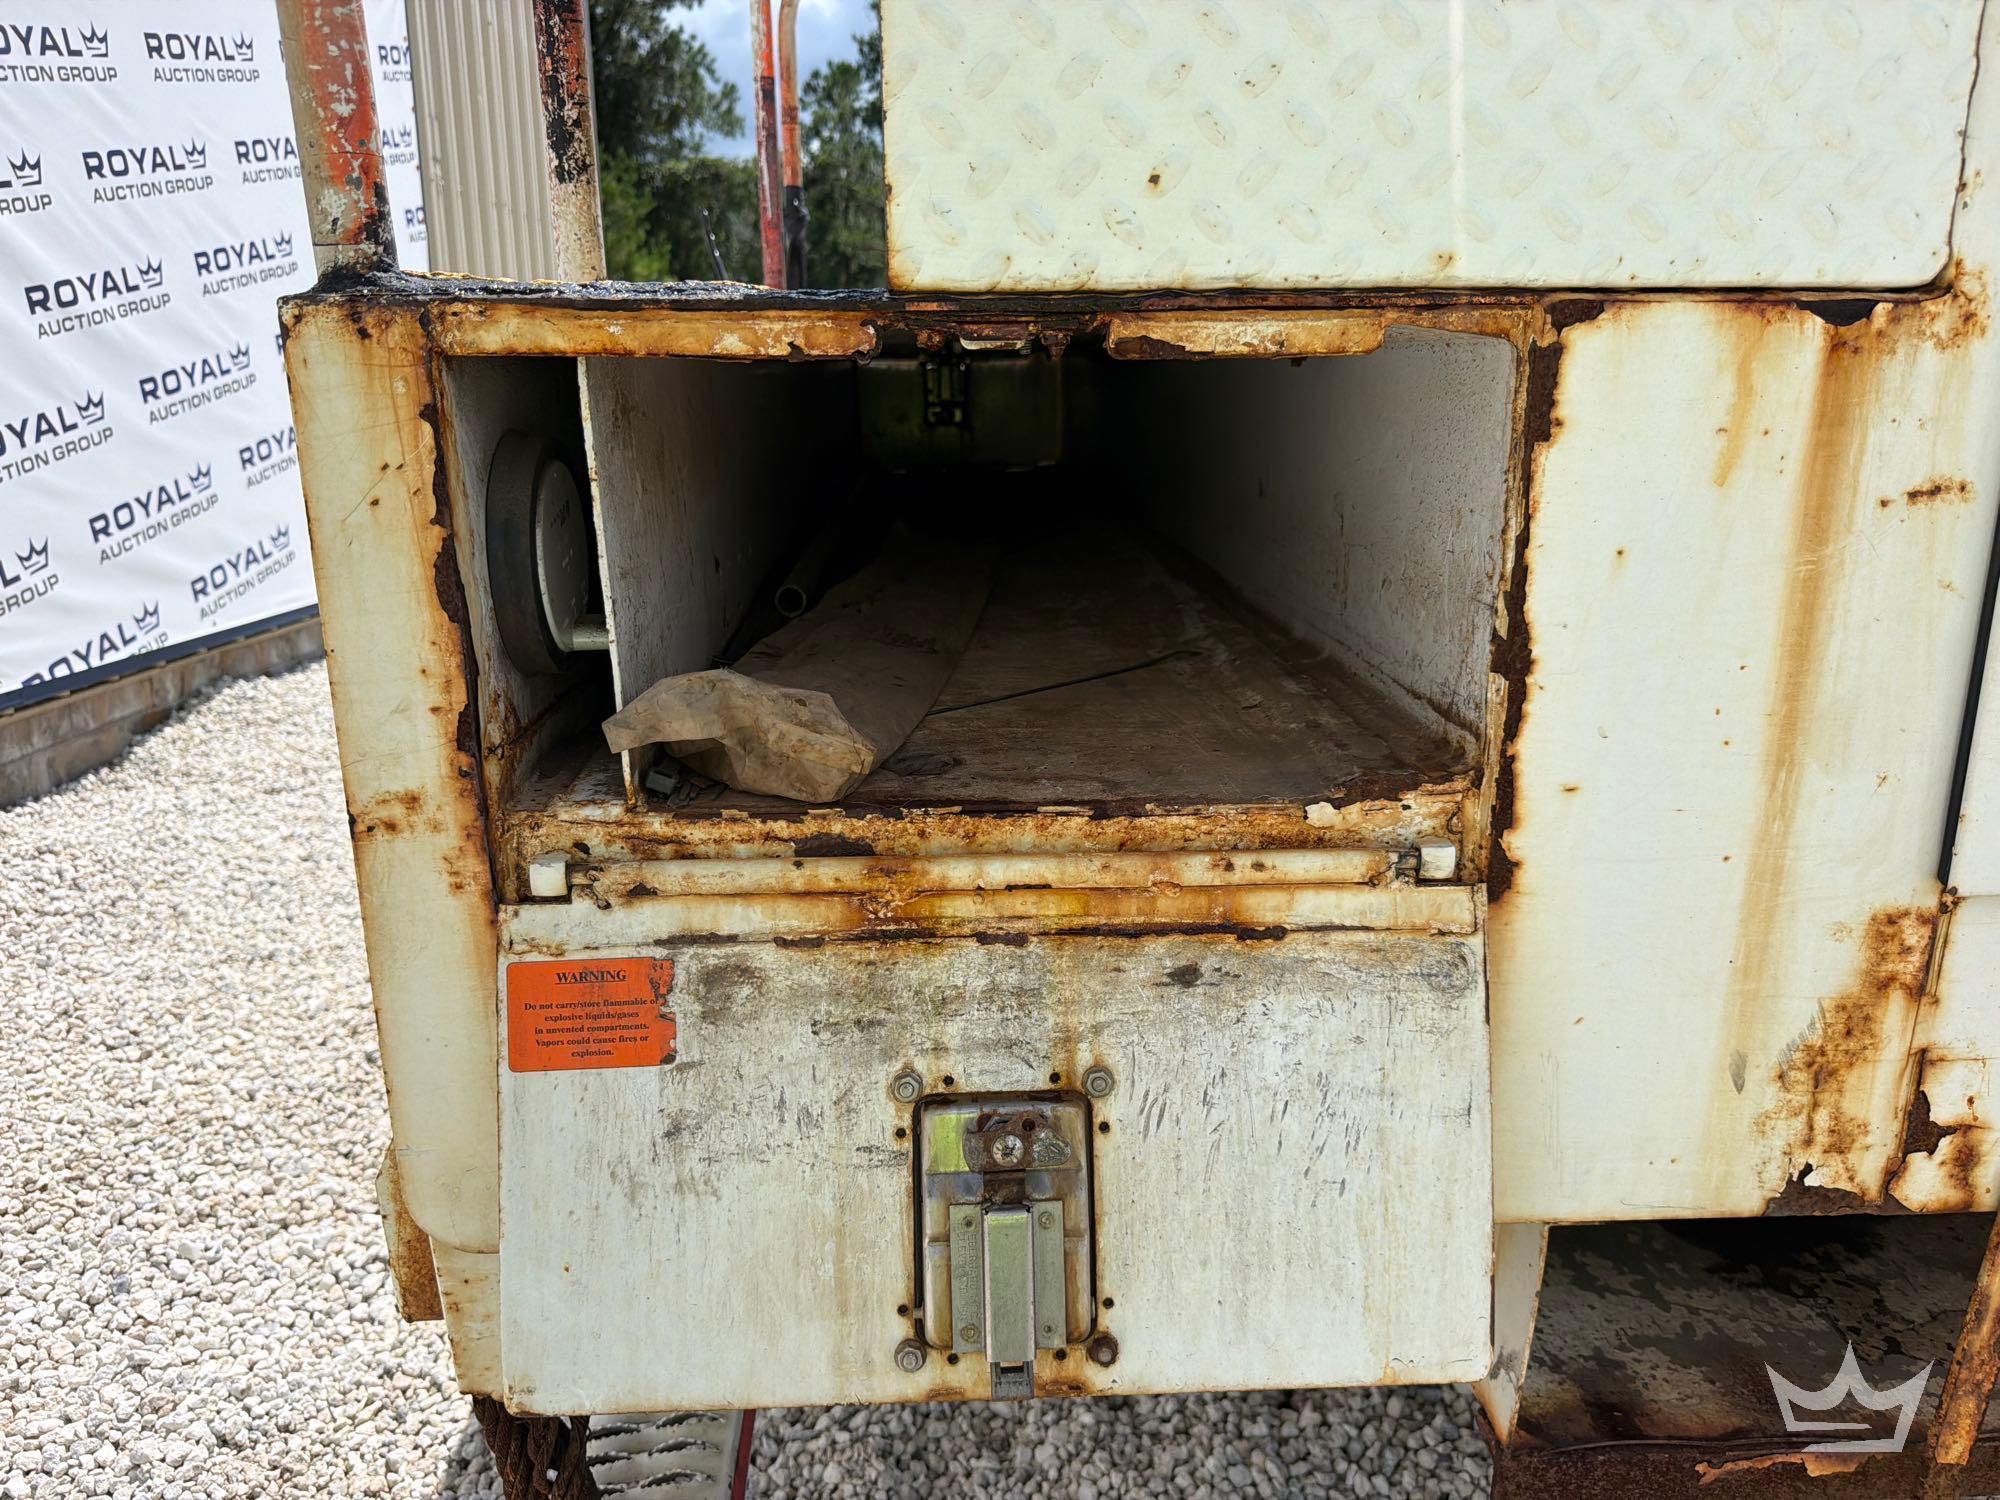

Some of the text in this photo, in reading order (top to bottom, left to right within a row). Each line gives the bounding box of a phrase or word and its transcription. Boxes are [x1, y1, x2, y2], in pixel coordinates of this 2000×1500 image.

[143, 32, 235, 61] ROYAL
[378, 45, 410, 65] ROY
[0, 65, 118, 82] CTION GROUP
[153, 67, 260, 83] AUCTION GROUP
[81, 146, 186, 180] ROYAL
[234, 137, 297, 165] ROYA
[93, 176, 214, 204] AUCTION GROUP
[242, 166, 292, 184] AUCTION
[0, 194, 52, 215] ROUP
[194, 238, 276, 277] ROYAL
[24, 265, 140, 316] ROYAL
[202, 262, 299, 298] AUCTION GROUP
[37, 293, 171, 339] AUCTION GROUP
[139, 353, 231, 404] ROYAL
[149, 373, 257, 425] AUCTION GROUP
[0, 406, 78, 457] YAL
[239, 426, 296, 471] ROYA
[0, 427, 114, 484] TION GROUP
[89, 478, 191, 544] ROYAL
[100, 493, 219, 565] AUCTION GROUP
[190, 539, 273, 604] ROYAL
[200, 551, 296, 621] AUCTION GROUP
[0, 574, 59, 618] ROUP
[556, 969, 627, 983] WARNING
[524, 1002, 536, 1011] Do
[539, 1002, 553, 1010] not
[555, 1000, 600, 1010] carry/store
[603, 998, 647, 1008] flammable
[544, 1011, 640, 1023] explosive liquids/gases
[534, 1023, 650, 1035] in unvented compartments.
[535, 1038, 564, 1048] Vapors
[567, 1036, 591, 1046] could
[592, 1037, 616, 1045] cause
[618, 1035, 637, 1044] fires
[571, 1049, 614, 1058] explosion.
